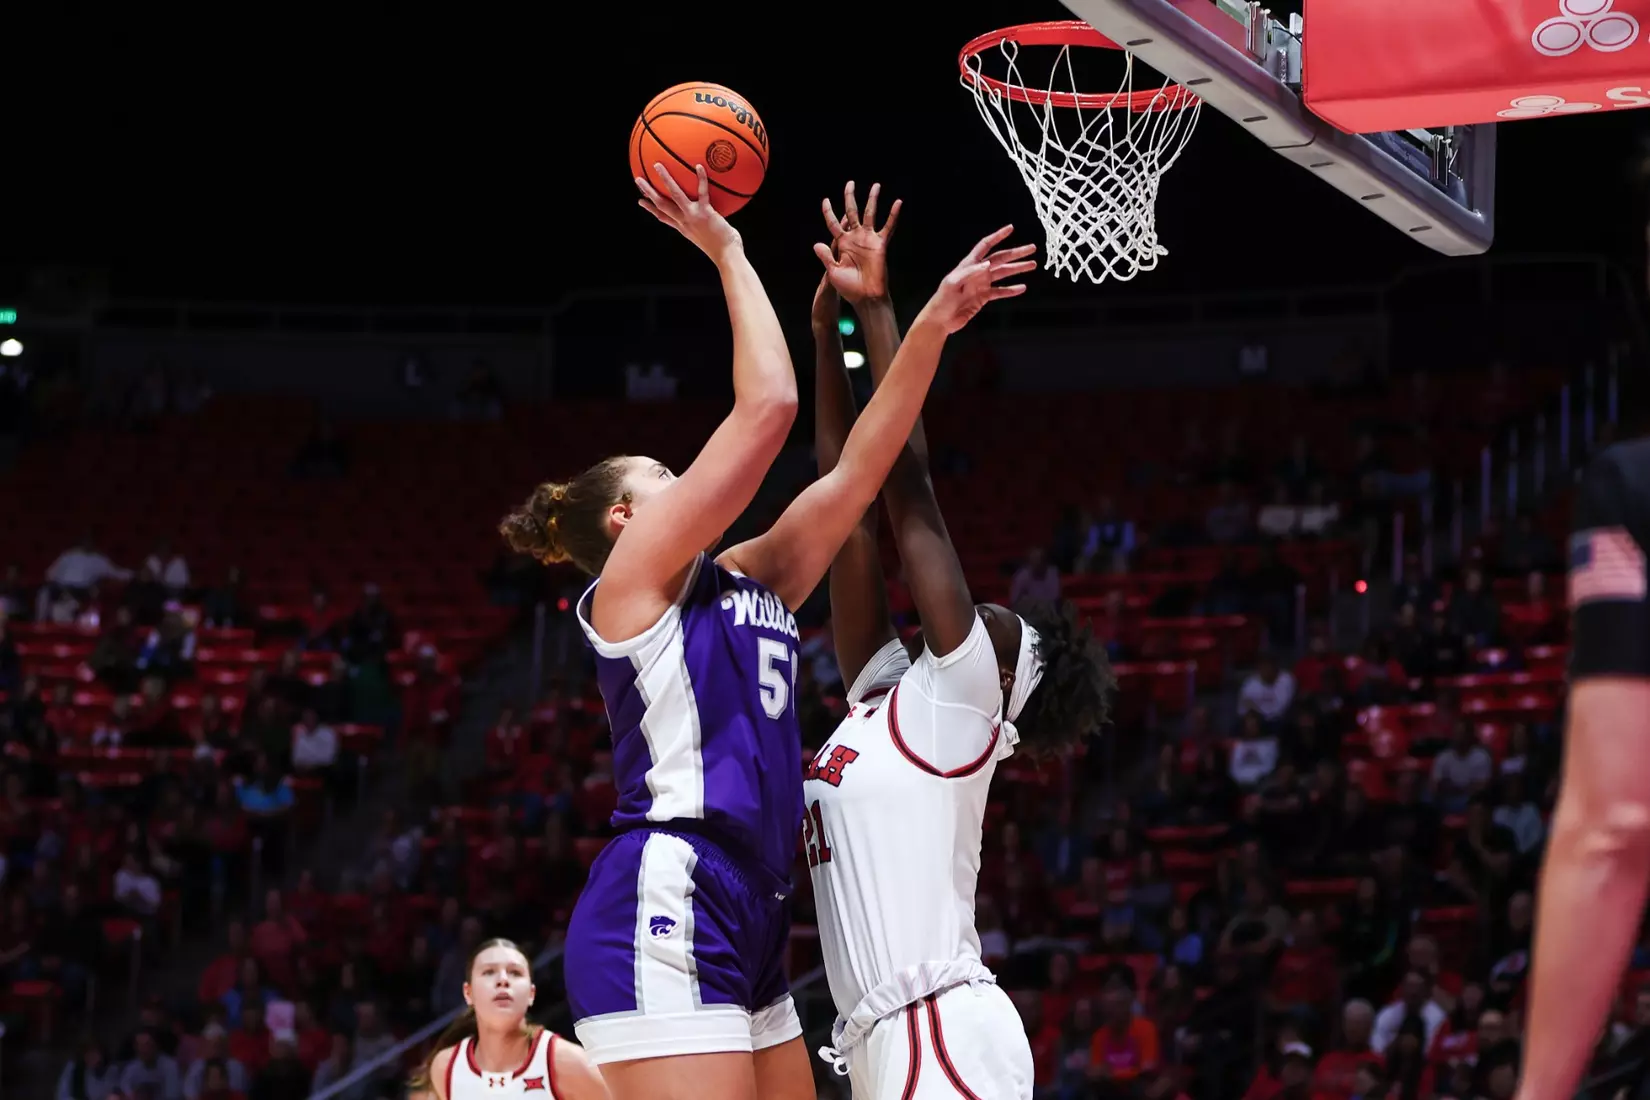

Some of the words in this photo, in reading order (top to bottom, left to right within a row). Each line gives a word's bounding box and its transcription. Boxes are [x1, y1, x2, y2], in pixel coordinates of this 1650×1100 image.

[694, 92, 767, 152] Wilson
[721, 588, 800, 642] Wildc
[757, 636, 798, 720] 5
